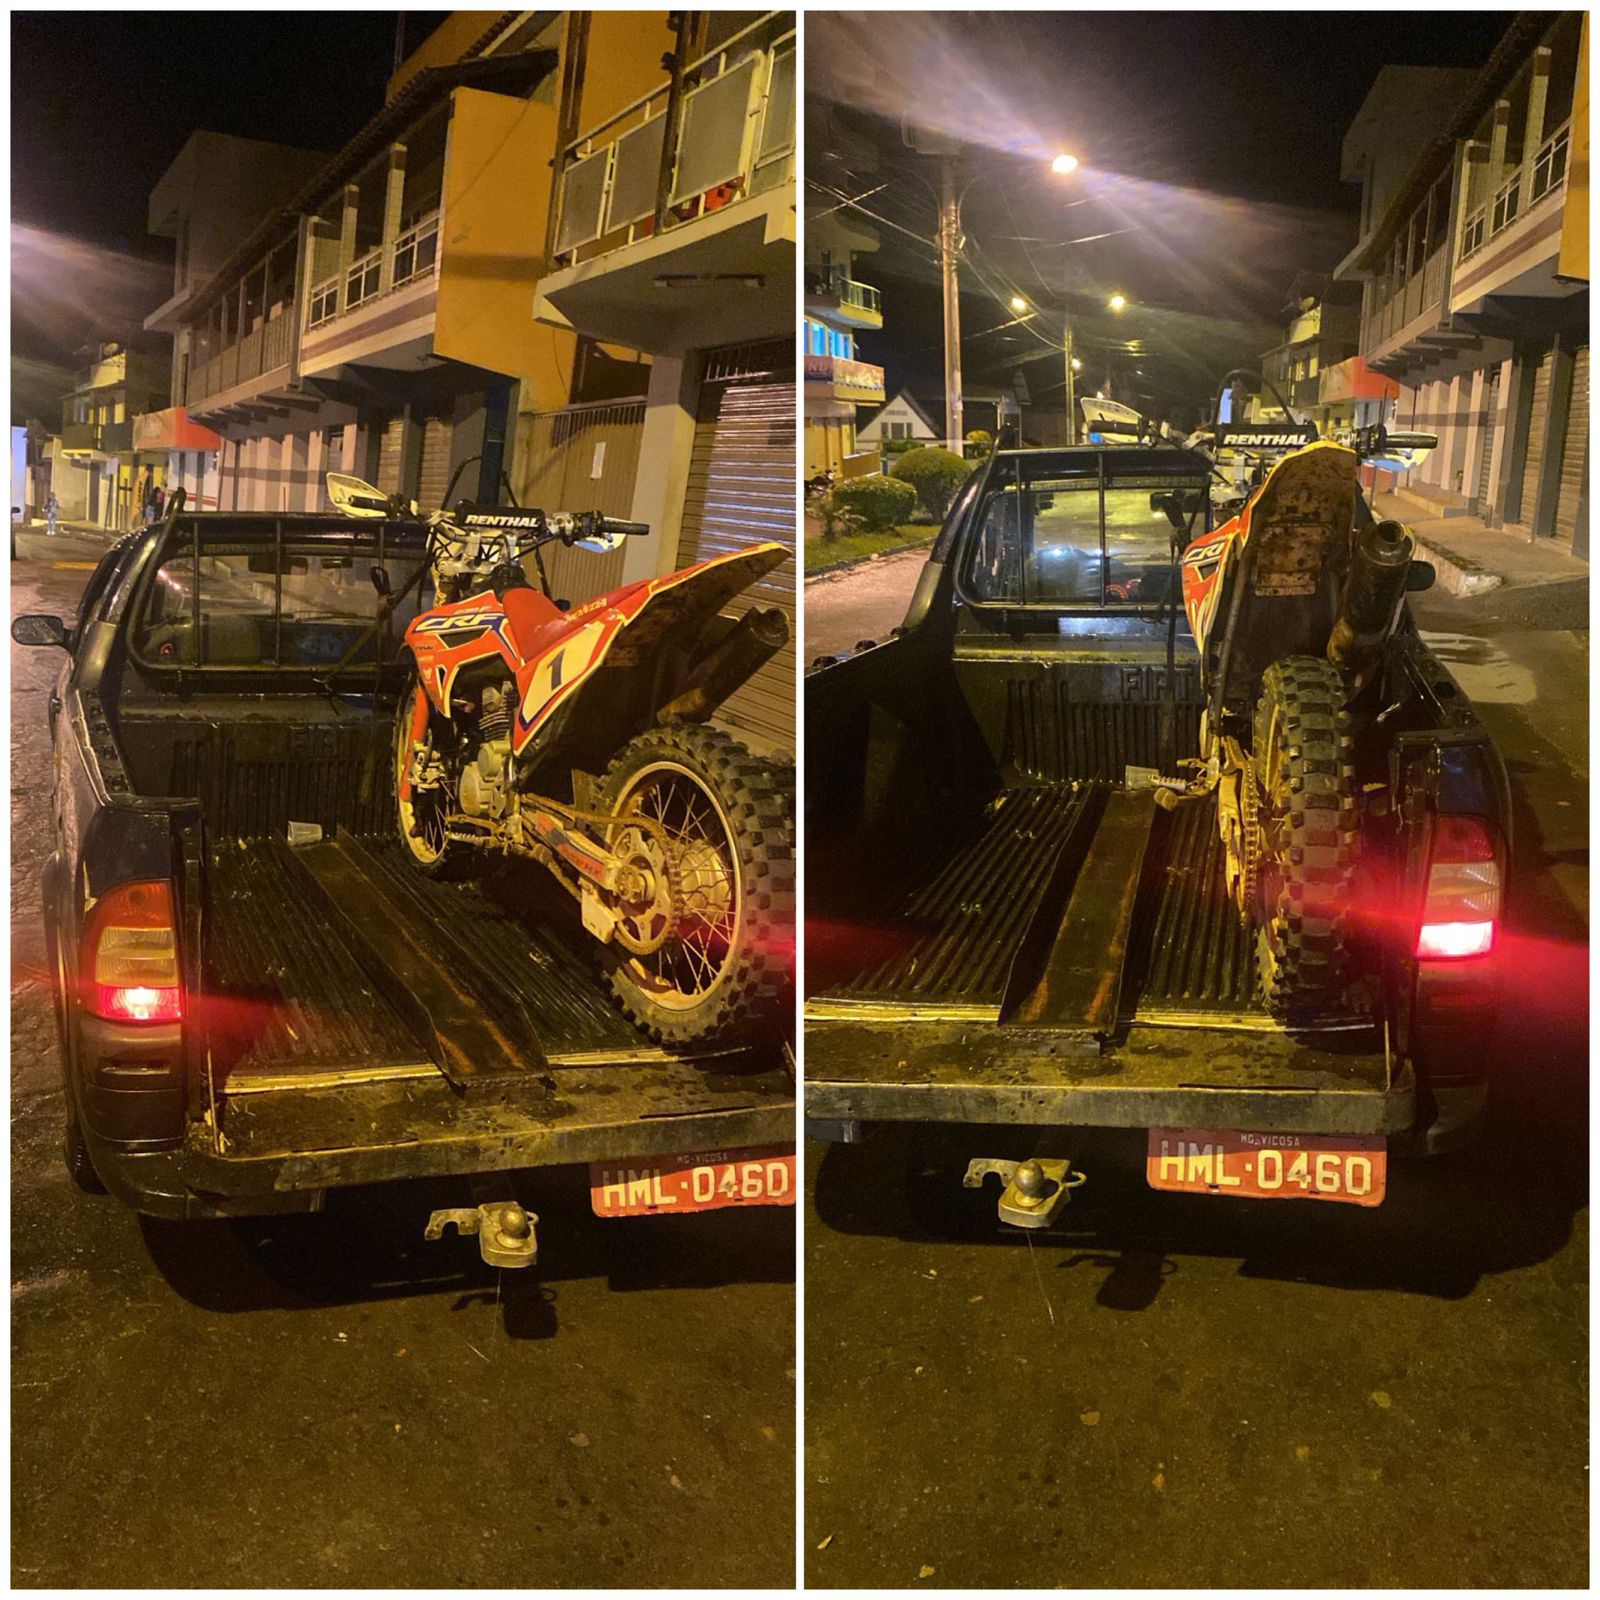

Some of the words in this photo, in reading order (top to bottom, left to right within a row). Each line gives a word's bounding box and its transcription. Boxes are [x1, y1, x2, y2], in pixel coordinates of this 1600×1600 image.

[1223, 434, 1308, 446] RENTHAL
[464, 514, 539, 528] RENTHAL
[415, 612, 504, 631] CRF
[547, 648, 565, 692] 1
